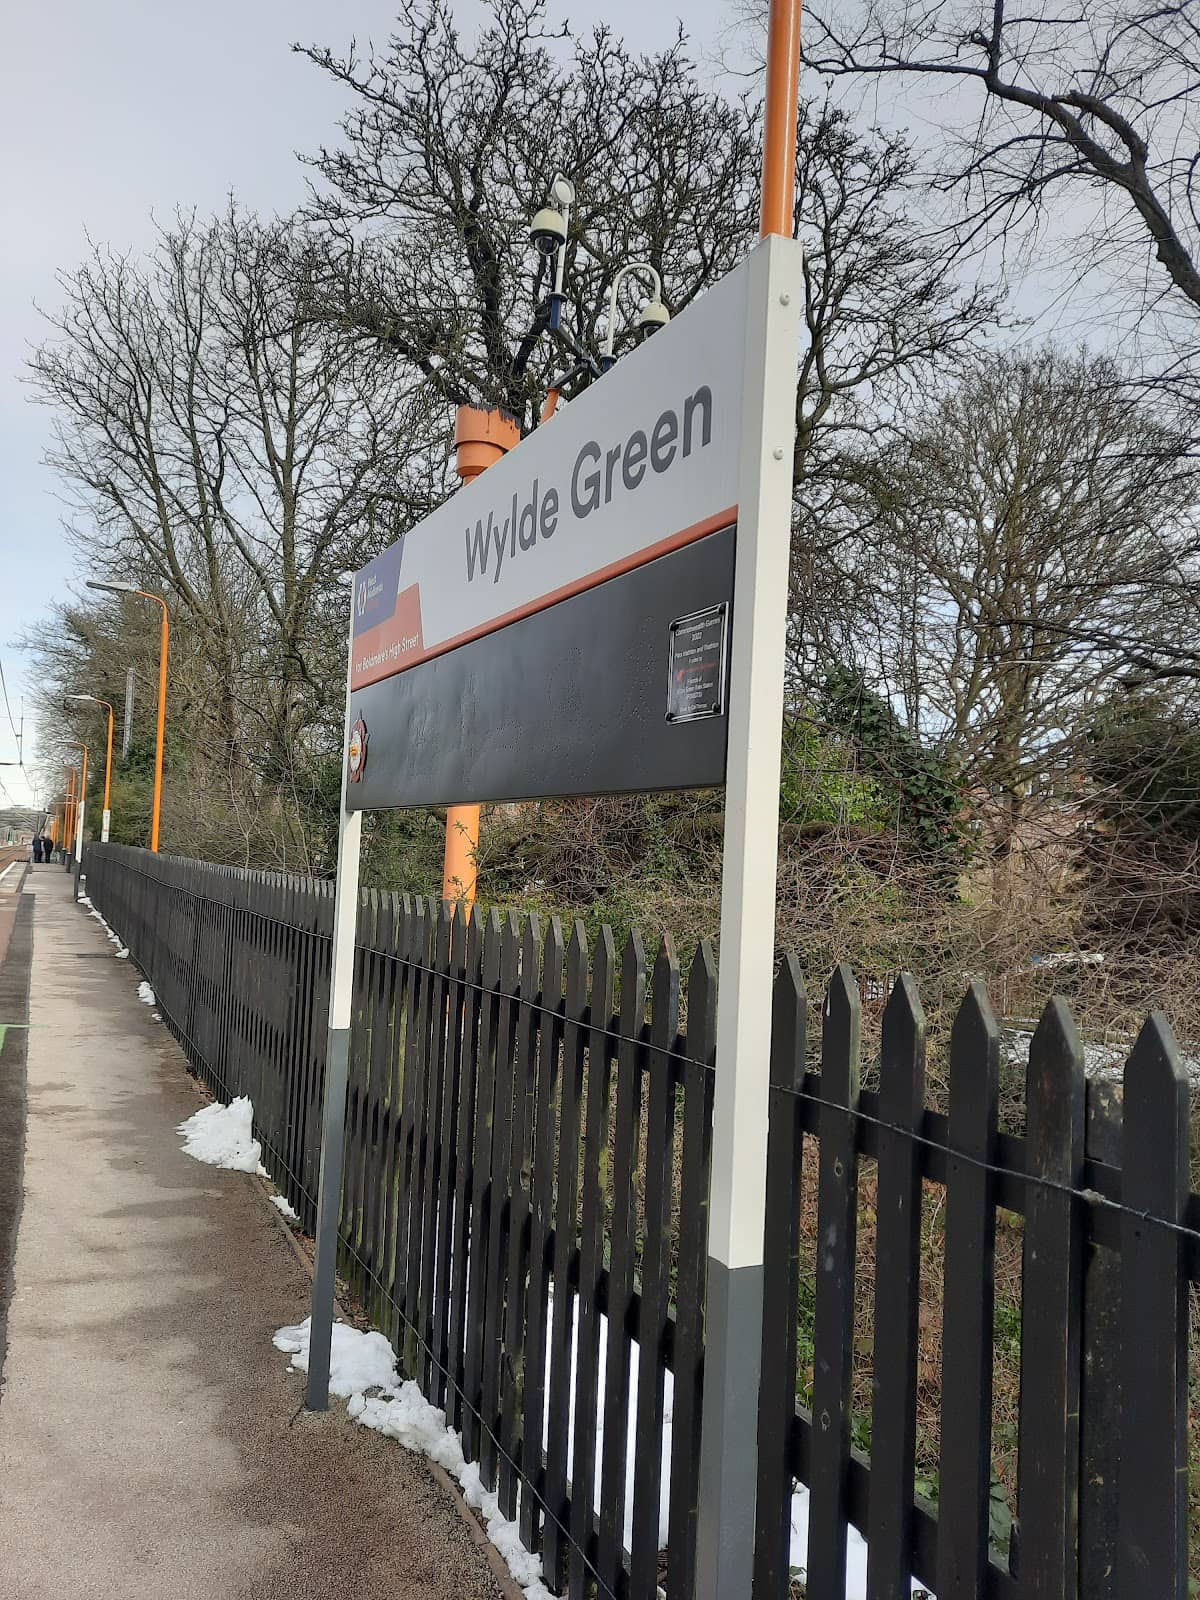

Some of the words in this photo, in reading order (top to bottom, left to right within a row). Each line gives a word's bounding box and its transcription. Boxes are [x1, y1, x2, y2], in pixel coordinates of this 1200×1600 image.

[465, 478, 559, 584] Wylde
[571, 385, 713, 519] Green
[388, 640, 401, 660] High
[400, 631, 419, 654] Street
